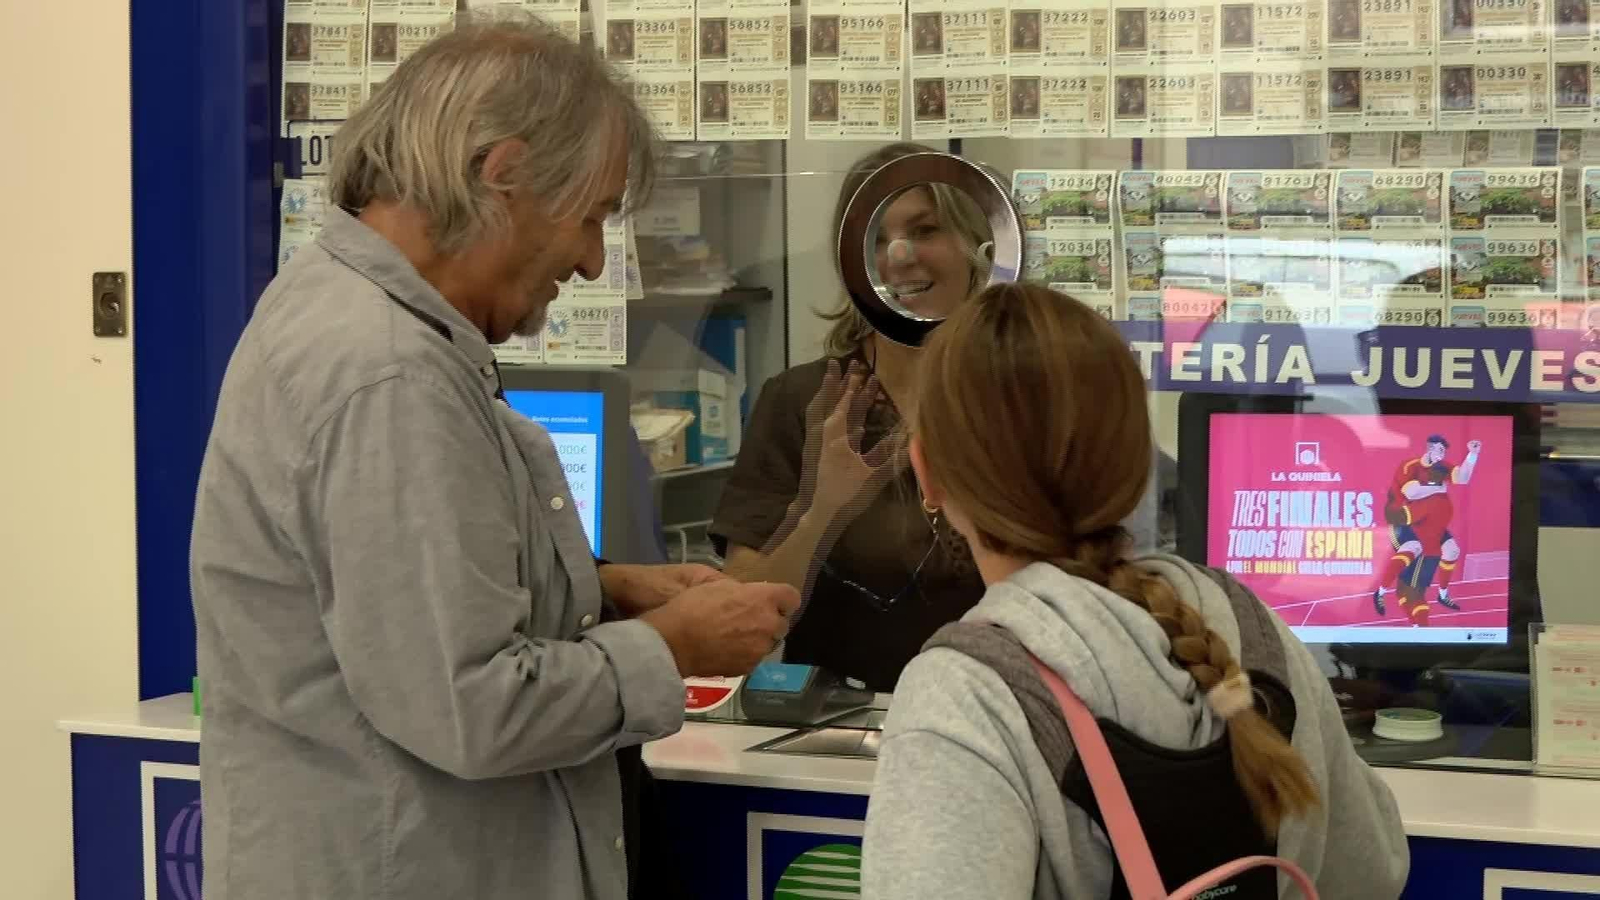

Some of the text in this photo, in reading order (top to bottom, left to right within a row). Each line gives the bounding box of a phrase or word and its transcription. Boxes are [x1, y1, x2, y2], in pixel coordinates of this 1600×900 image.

[1043, 11, 1090, 23] 37222
[1149, 8, 1196, 21] 22603
[1257, 5, 1303, 17] 11572
[728, 19, 771, 31] 56852
[840, 18, 884, 29] 95166
[944, 13, 988, 26] 37111
[636, 21, 675, 33] 23364
[1363, 69, 1412, 82] 23891
[1476, 66, 1527, 79] 00330
[946, 79, 990, 93] 37111
[1042, 78, 1088, 91] 37222
[1149, 77, 1196, 90] 22603
[1257, 74, 1302, 87] 11572
[311, 86, 348, 96] 37841
[730, 83, 772, 95] 56852
[840, 82, 883, 95] 95166
[1050, 177, 1095, 189] 12034
[1263, 176, 1312, 187] 91763
[1374, 175, 1423, 186] 68290
[1487, 175, 1538, 187] 99636
[1051, 241, 1095, 253] 12034
[1487, 241, 1537, 253] 99636
[572, 308, 609, 321] 40470
[1487, 310, 1538, 322] 99636
[1350, 347, 1600, 393] JUEVES
[1271, 472, 1342, 482] LA QUINIELA
[1231, 490, 1267, 527] TRES
[1227, 525, 1374, 559] TODOS CON ESPAÑA
